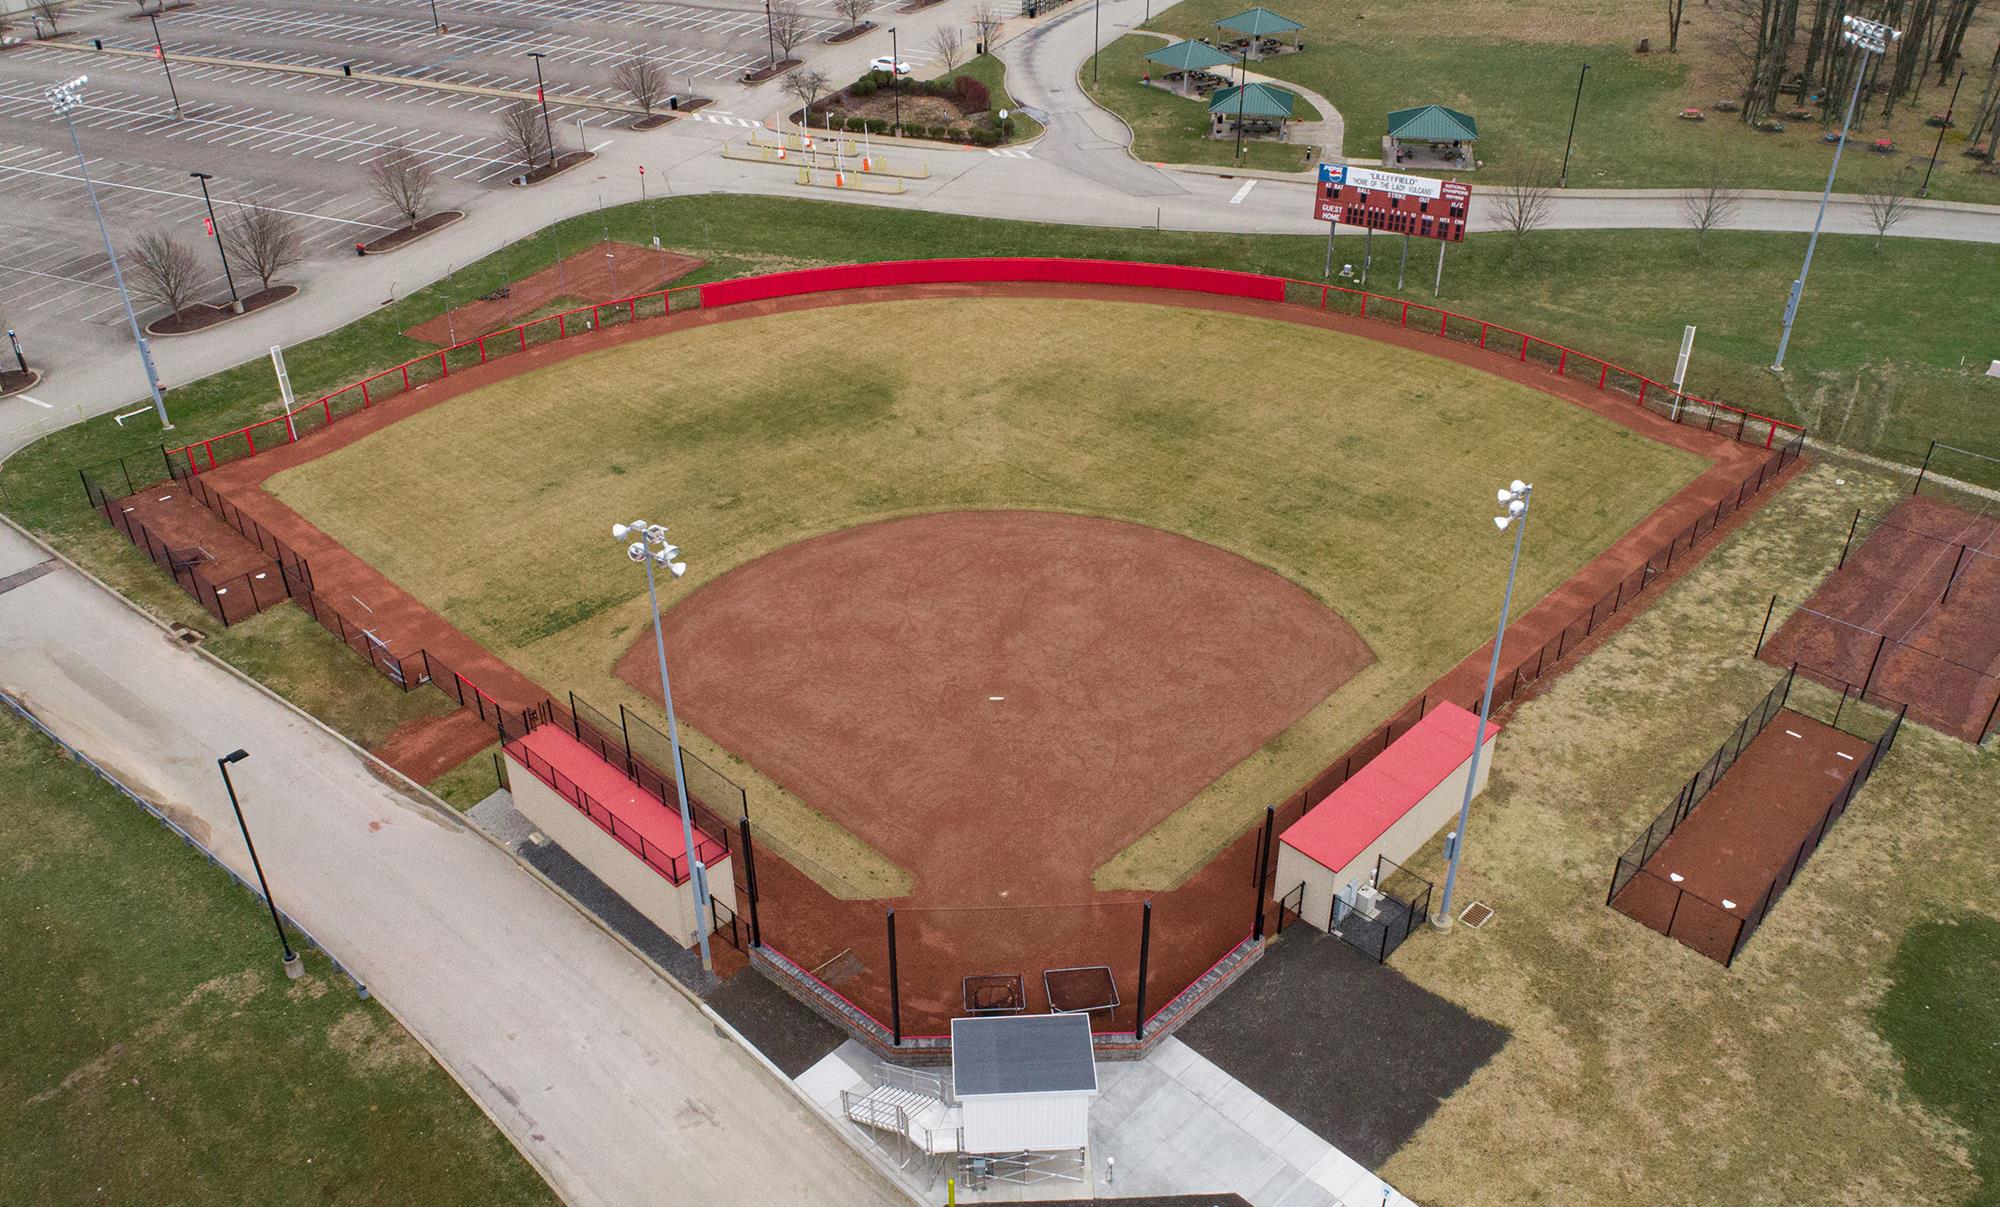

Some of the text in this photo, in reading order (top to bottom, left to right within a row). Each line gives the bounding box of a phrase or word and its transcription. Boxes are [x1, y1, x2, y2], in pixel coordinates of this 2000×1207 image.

[1380, 181, 1390, 190] THE
[1357, 187, 1371, 195] BALL
[1387, 192, 1407, 200] STRIKE
[1419, 196, 1430, 204] OUT
[1322, 204, 1343, 214] GUEST
[1322, 212, 1342, 222] HOME
